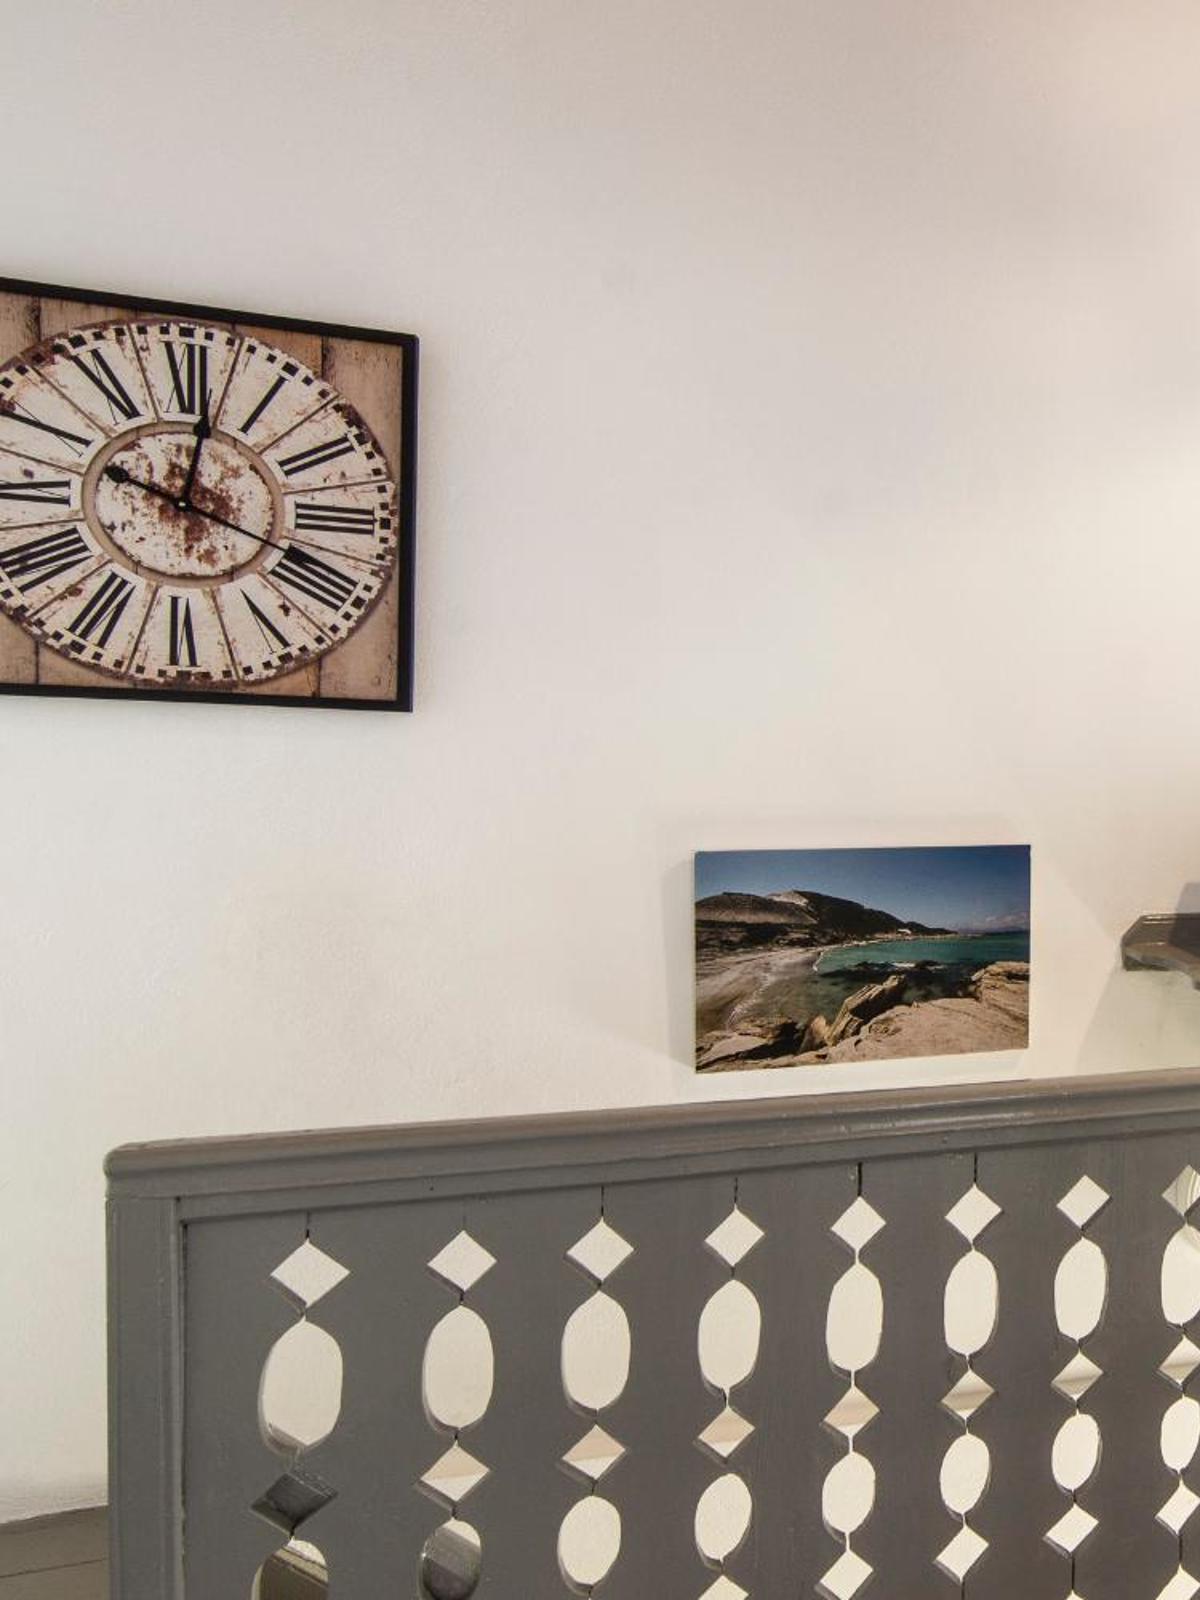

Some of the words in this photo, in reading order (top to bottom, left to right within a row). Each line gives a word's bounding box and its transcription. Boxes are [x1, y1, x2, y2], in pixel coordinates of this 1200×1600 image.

[70, 346, 144, 426] XI
[160, 340, 212, 416] XII
[237, 373, 289, 436] I
[276, 433, 357, 478] II
[294, 501, 377, 538] III
[64, 569, 137, 650] VII
[166, 595, 200, 668] VI
[240, 588, 294, 655] V
